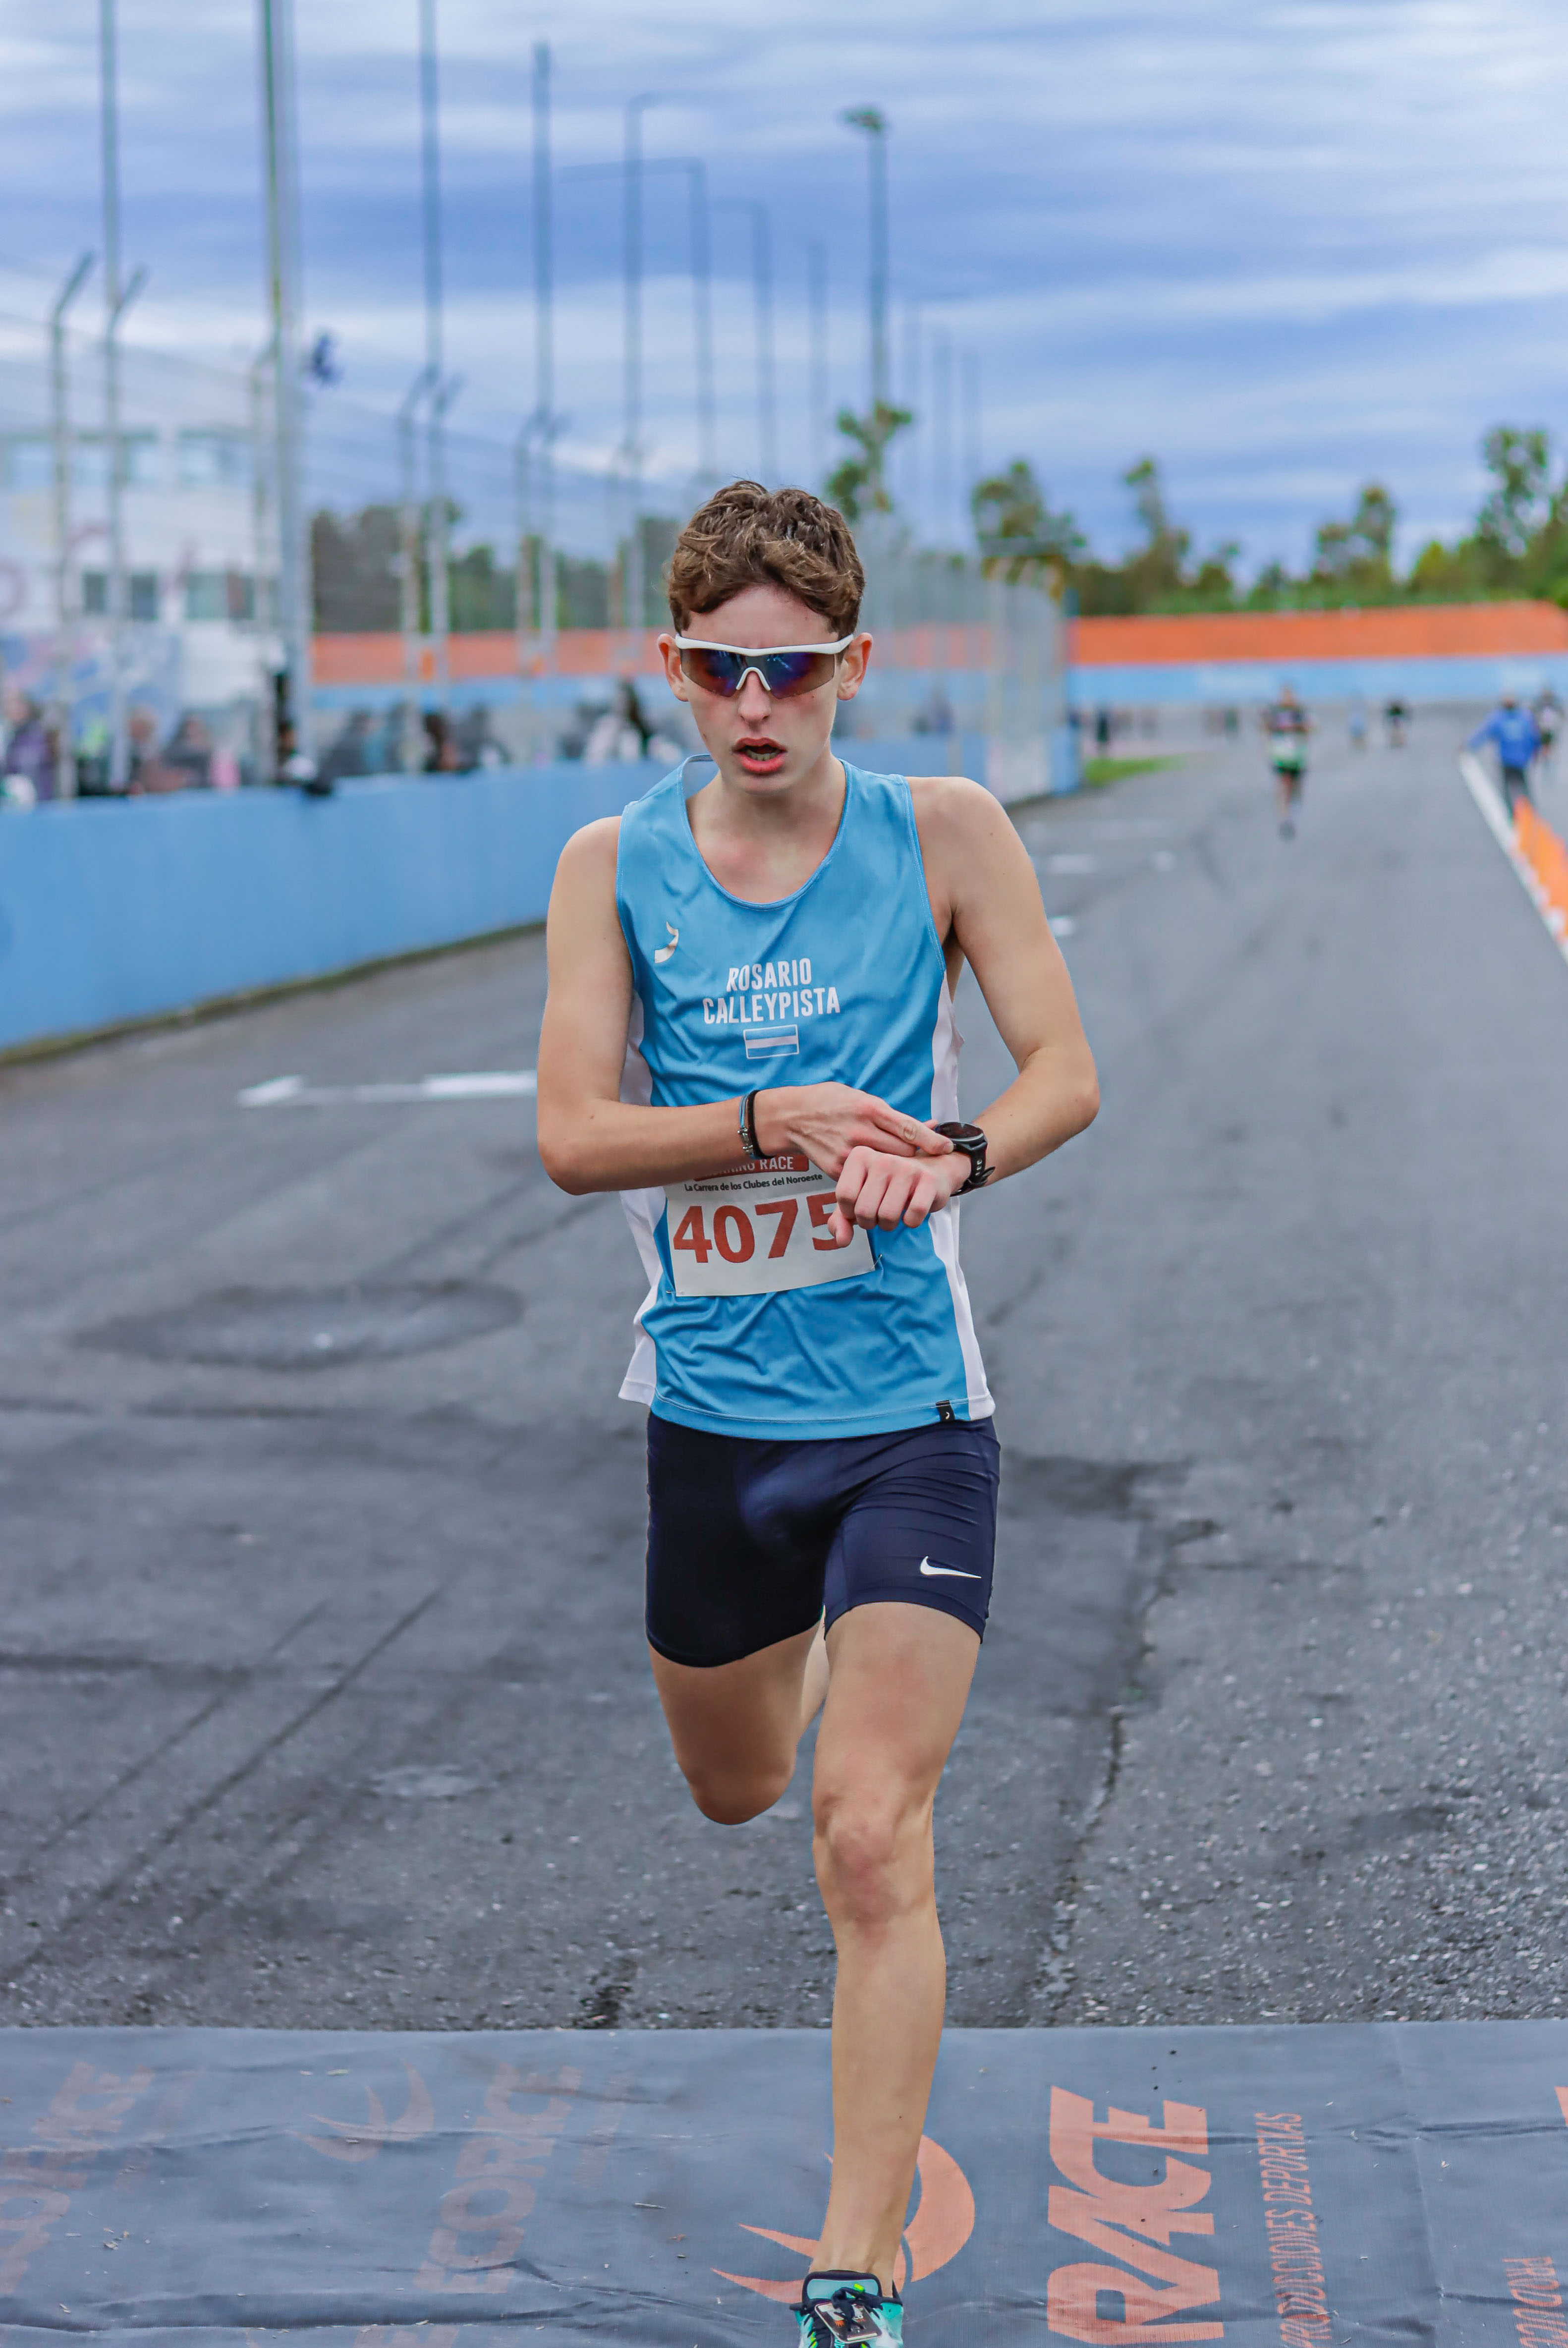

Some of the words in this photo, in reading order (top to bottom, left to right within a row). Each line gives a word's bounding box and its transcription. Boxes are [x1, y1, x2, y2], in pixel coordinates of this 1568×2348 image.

[726, 957, 812, 993] ROSARIO
[703, 987, 841, 1025] CALLEYPISTA
[760, 1156, 794, 1170] RACE
[684, 1183, 693, 1192] La
[694, 1183, 719, 1192] Carrera
[720, 1182, 729, 1190] de
[730, 1181, 742, 1190] los
[743, 1177, 771, 1189] Clubes
[772, 1176, 785, 1186] del
[786, 1173, 823, 1185] Noroeste
[673, 1191, 848, 1263] 4075
[1047, 2085, 1225, 2346] RACE
